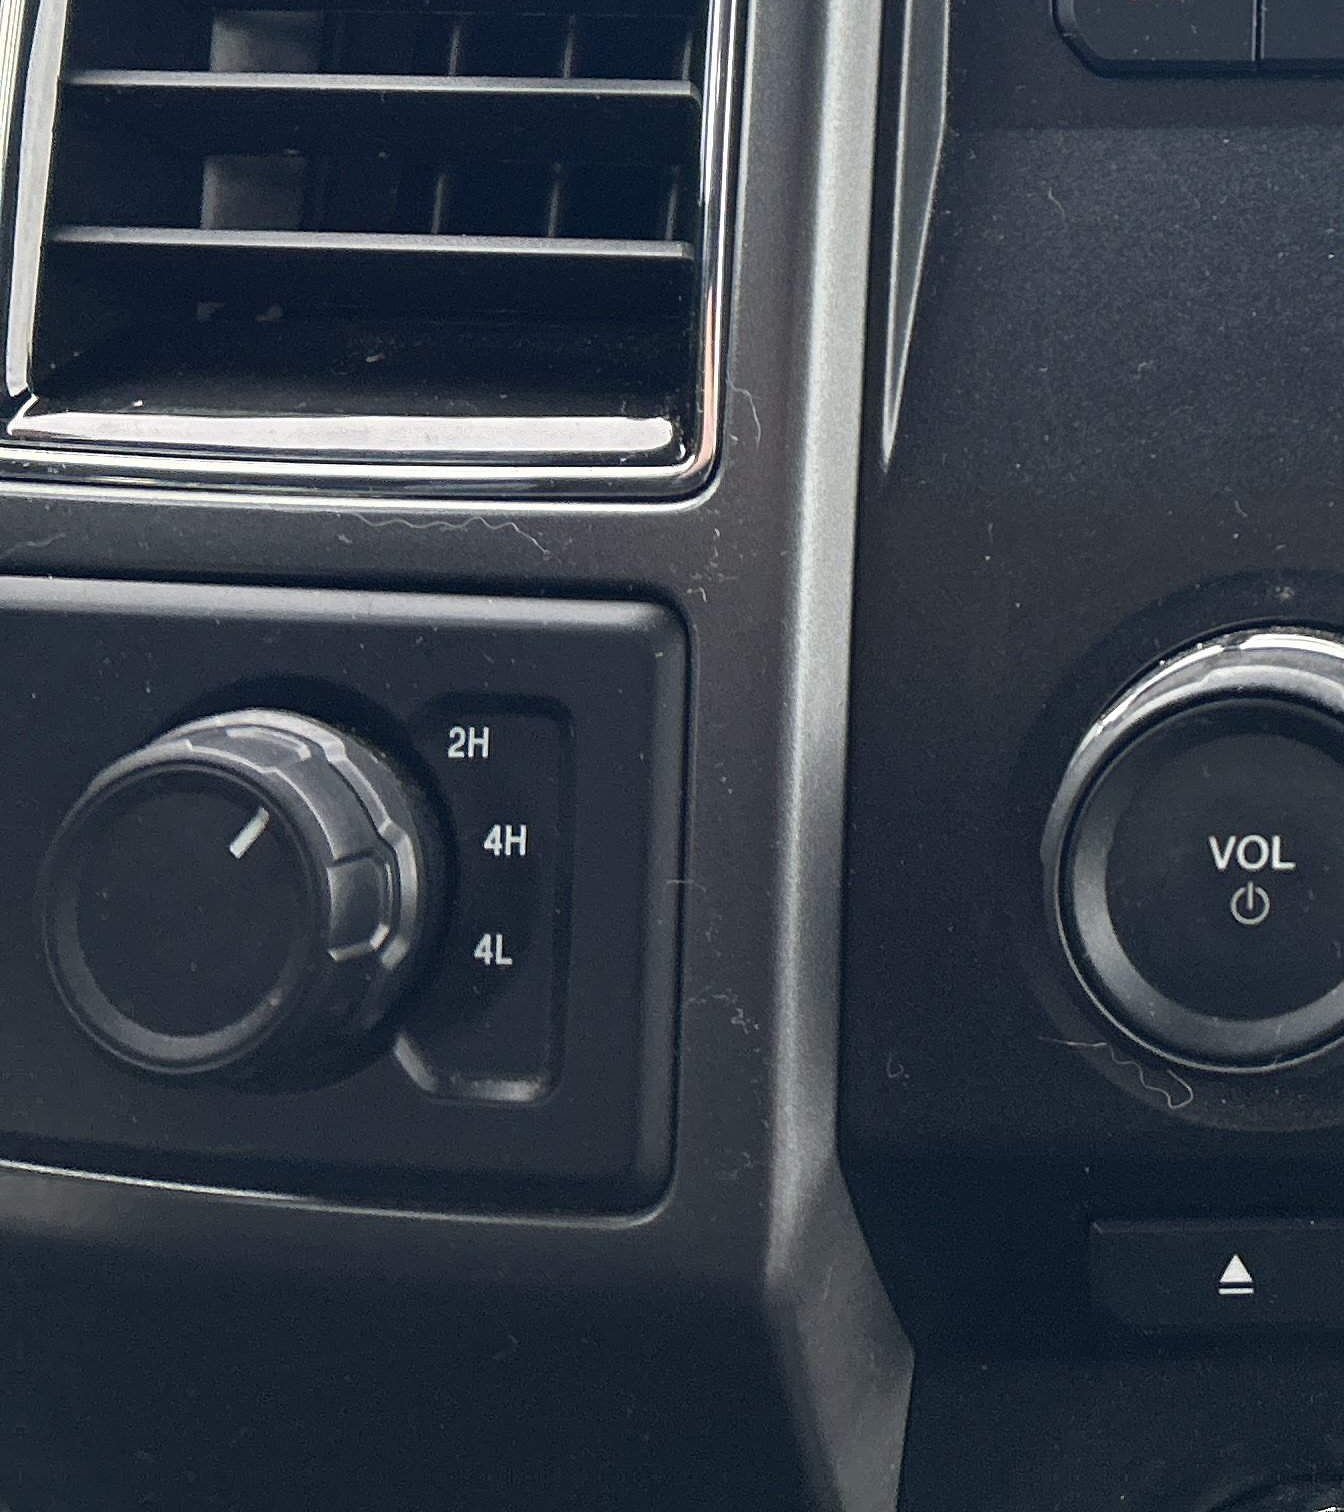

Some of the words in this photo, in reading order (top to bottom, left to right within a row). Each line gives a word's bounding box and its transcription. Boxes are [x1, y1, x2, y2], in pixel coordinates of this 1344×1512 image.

[447, 726, 490, 759] 2H
[483, 824, 527, 857] 4H
[1207, 834, 1297, 871] VOL
[473, 933, 513, 966] 4L
